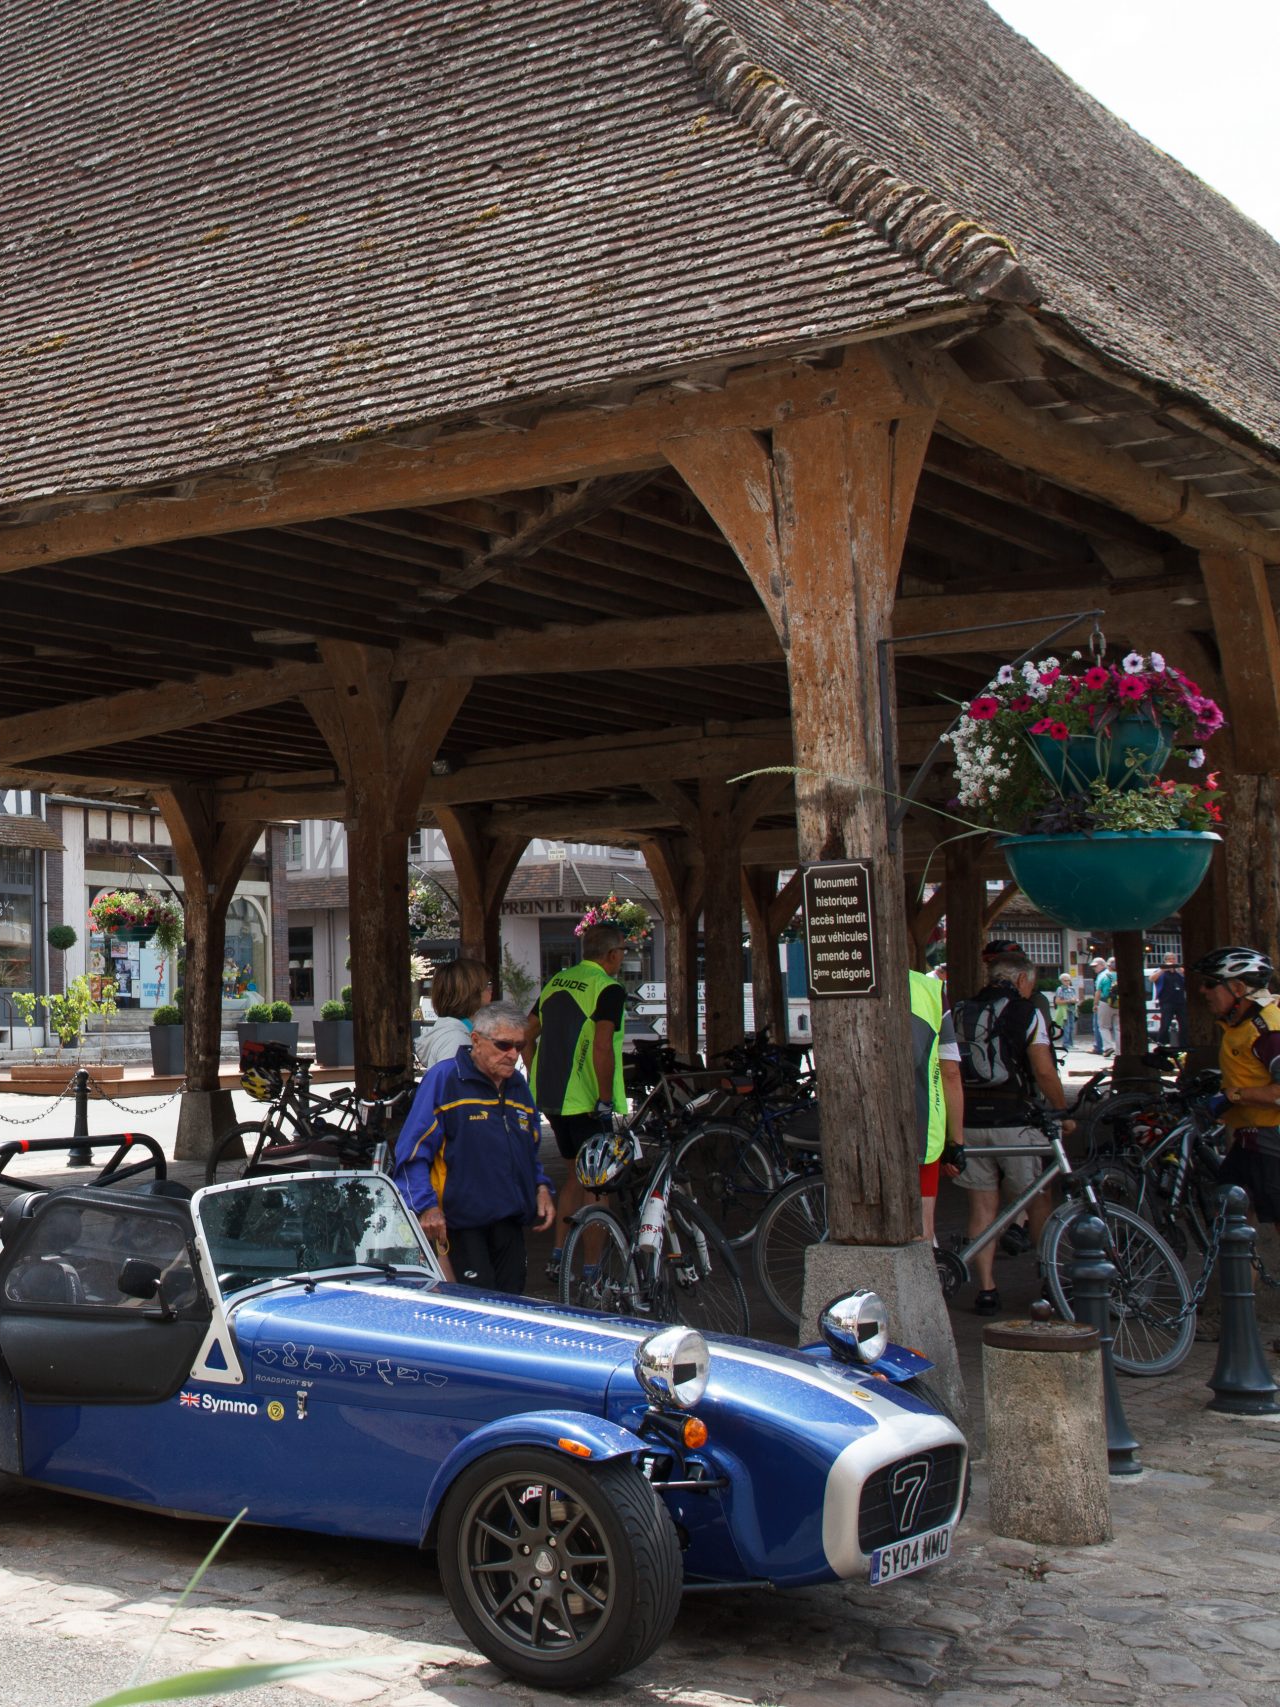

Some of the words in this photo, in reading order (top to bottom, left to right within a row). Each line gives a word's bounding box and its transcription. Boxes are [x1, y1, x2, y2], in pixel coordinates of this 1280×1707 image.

[814, 876, 858, 889] Monument
[501, 900, 566, 915] PREINTE
[816, 895, 858, 908] historique
[810, 913, 834, 926] accès
[836, 912, 866, 924] interdit
[811, 934, 826, 944] aux
[828, 931, 868, 943] véhicules
[817, 951, 849, 962] amende
[851, 949, 862, 960] de
[813, 969, 830, 980] 5ème
[831, 967, 870, 981] catégorie
[552, 978, 588, 992] GUIDE
[255, 1374, 300, 1386] ROADSPORT
[301, 1380, 313, 1388] SV
[201, 1393, 258, 1416] Symmo
[893, 1461, 929, 1533] 7
